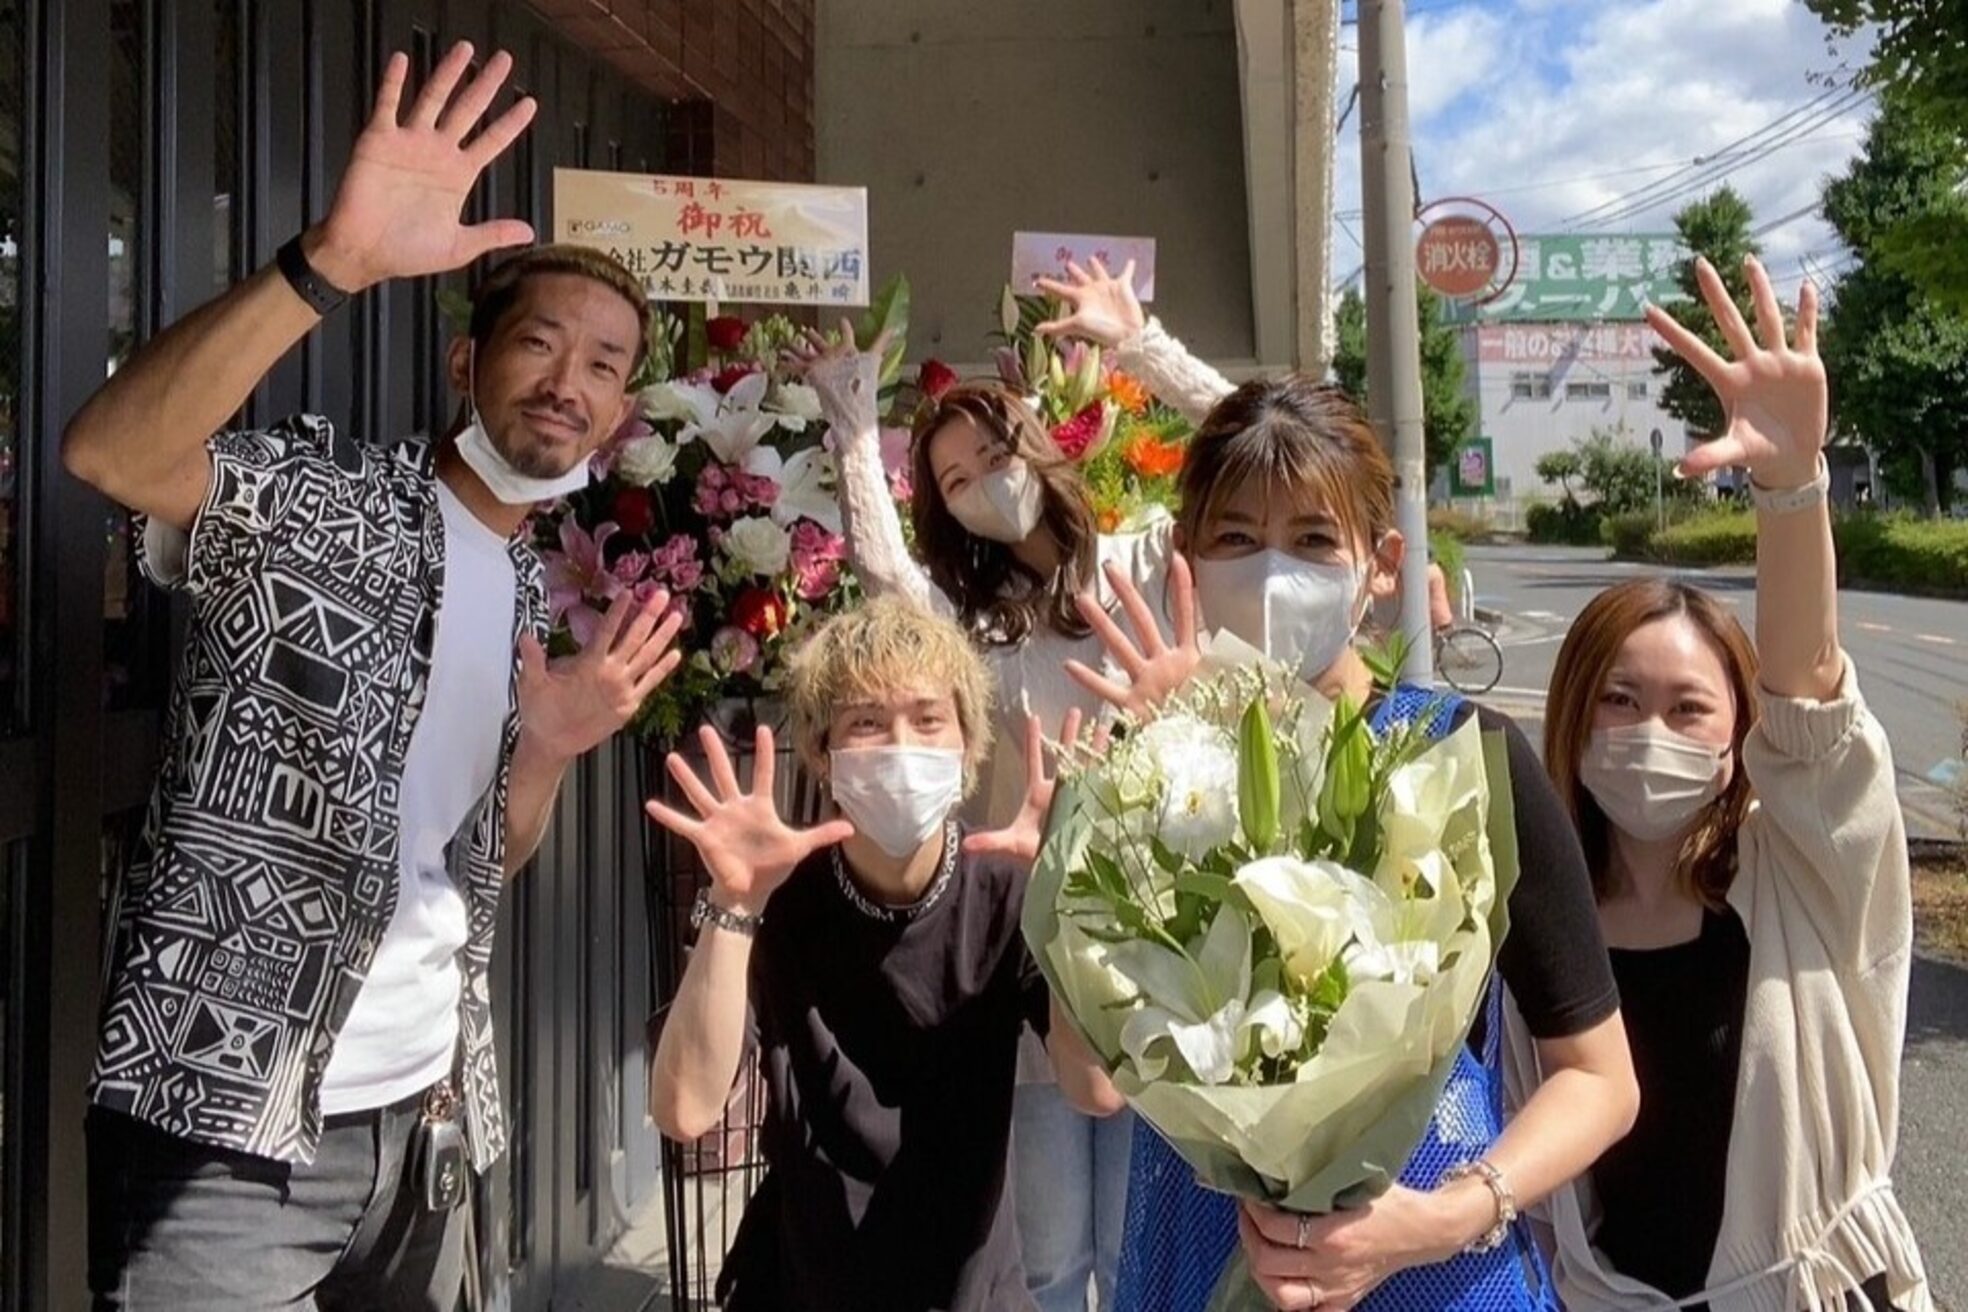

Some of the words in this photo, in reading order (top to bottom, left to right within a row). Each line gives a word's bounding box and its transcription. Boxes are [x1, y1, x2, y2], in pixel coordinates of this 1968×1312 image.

[653, 179, 731, 202] 5周年
[676, 201, 773, 239] 御祝
[1424, 241, 1492, 273] 消火栓
